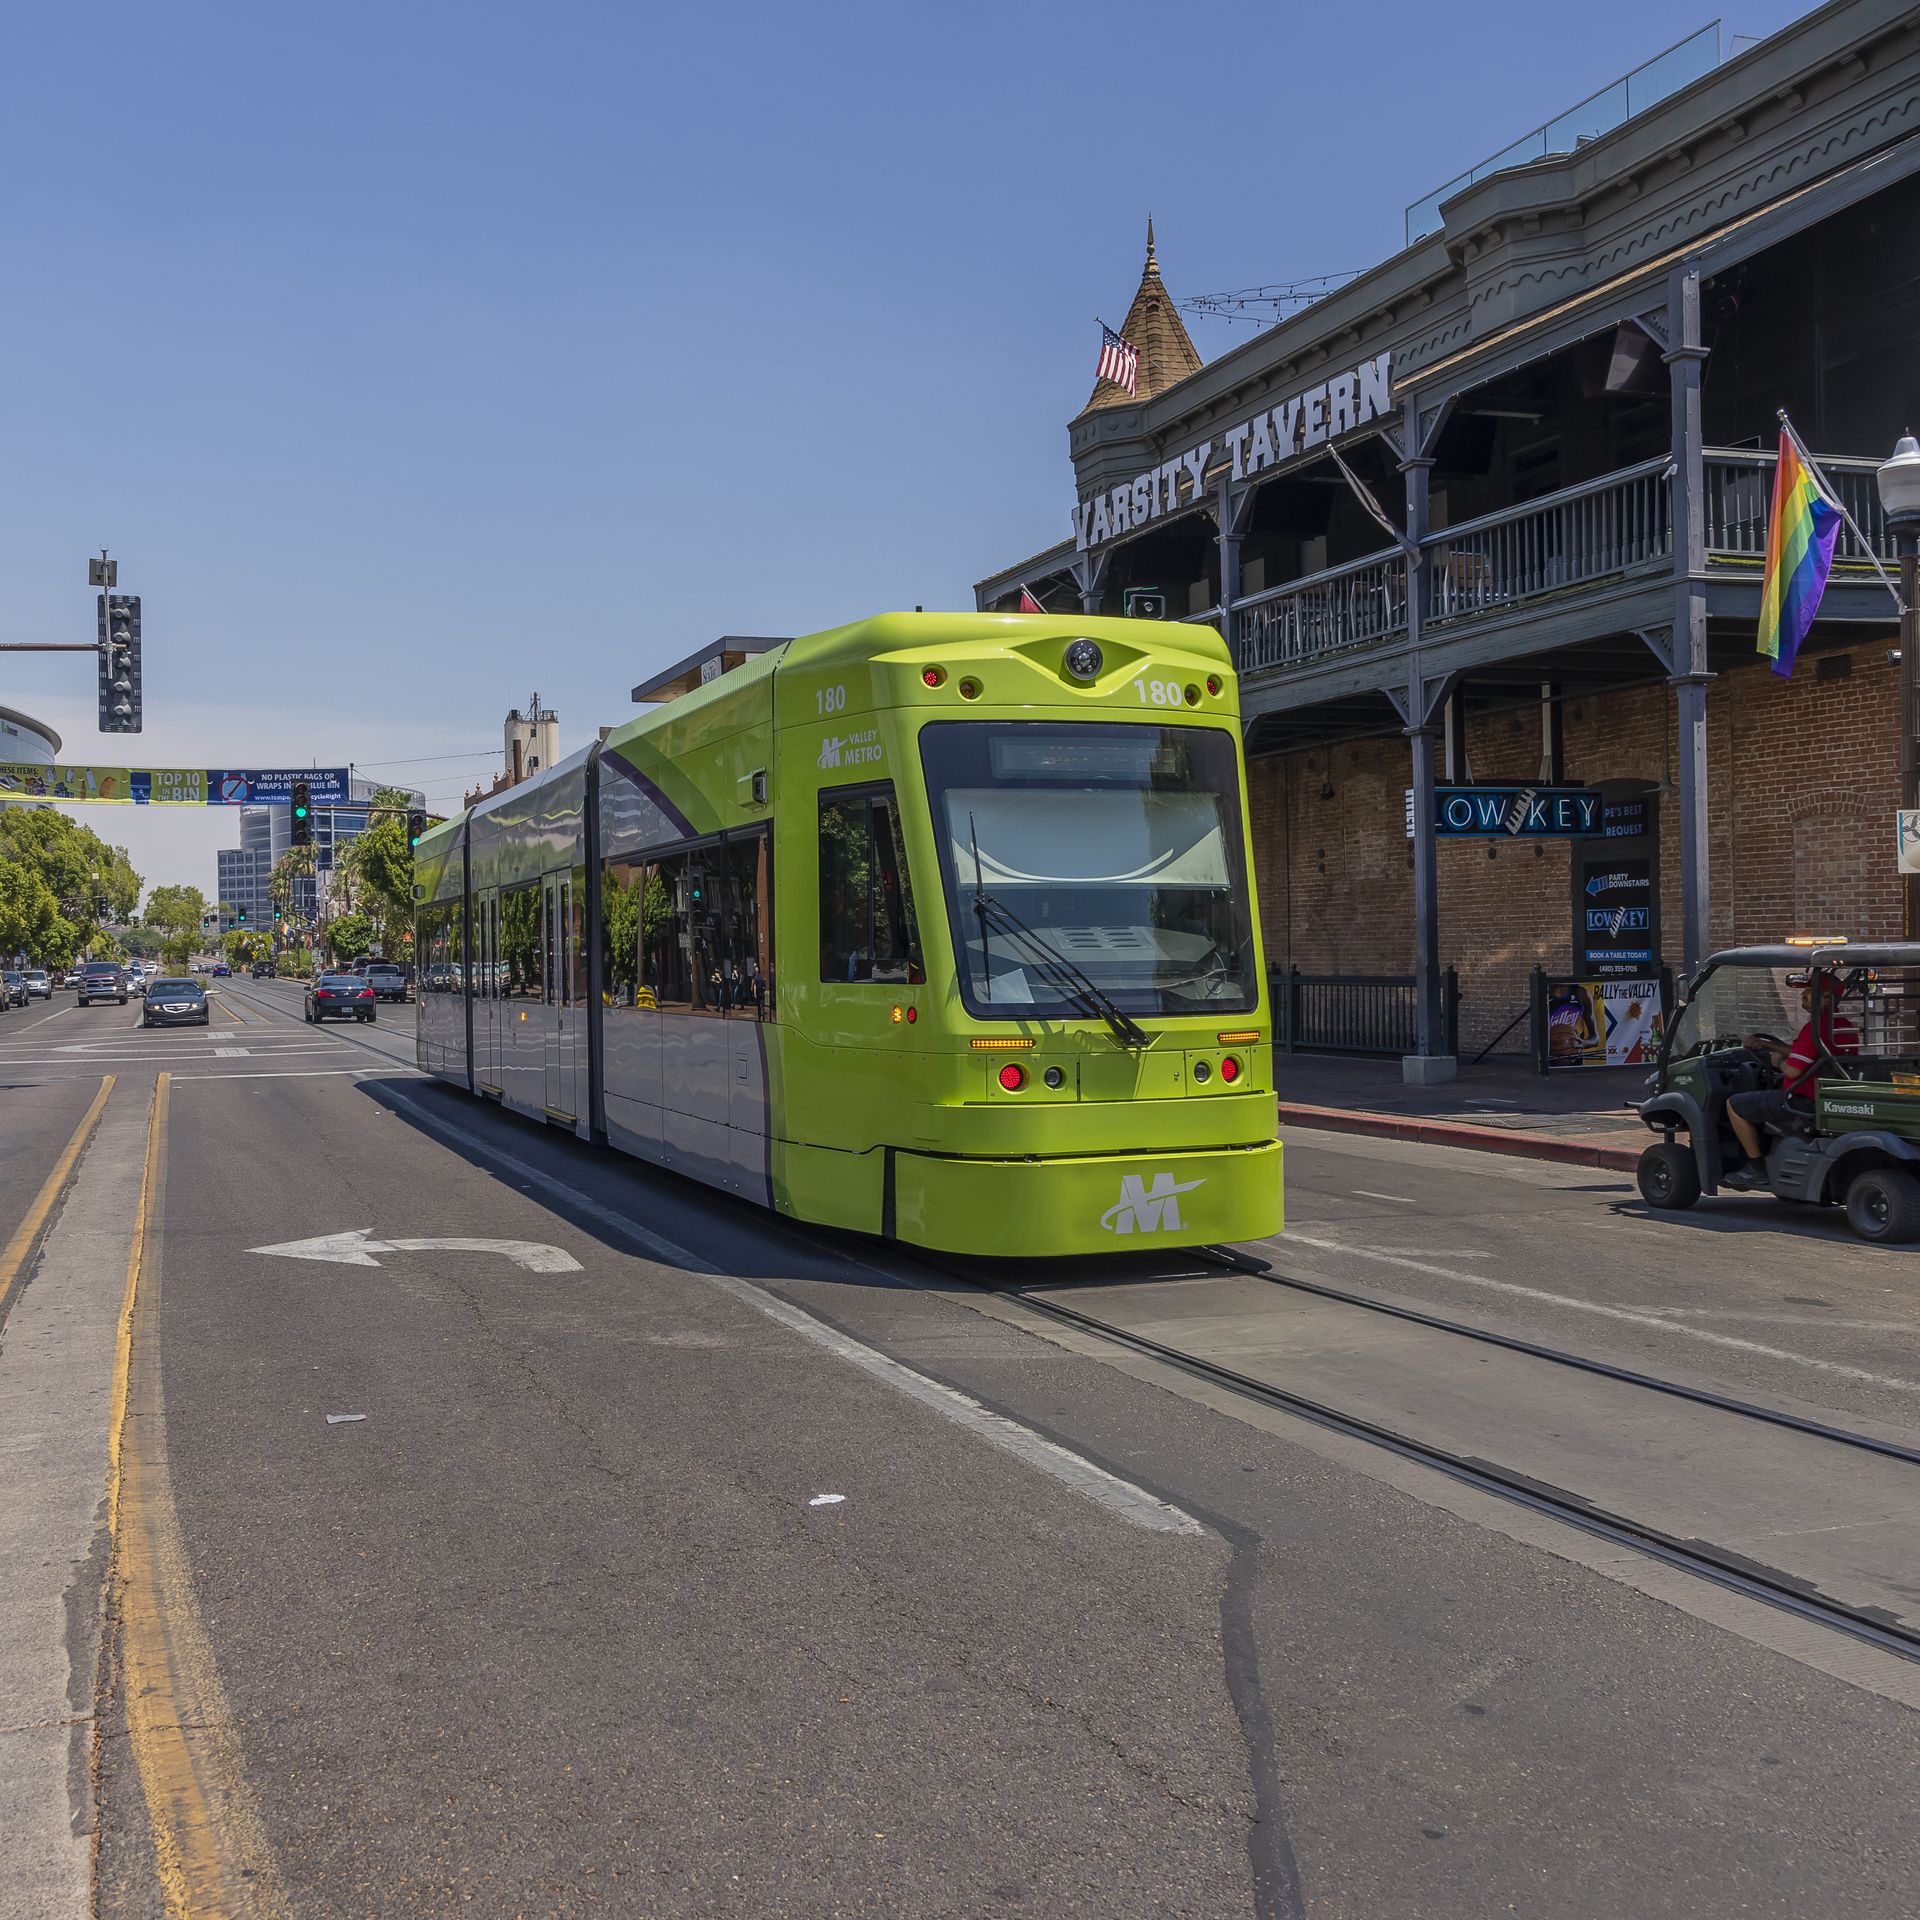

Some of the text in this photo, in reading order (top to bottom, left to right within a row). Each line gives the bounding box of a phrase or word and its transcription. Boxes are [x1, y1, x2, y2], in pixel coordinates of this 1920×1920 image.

[1071, 352, 1394, 551] VARSITY TAVERN
[816, 685, 846, 715] 180
[1133, 679, 1182, 706] 180
[849, 729, 877, 744] VALLEY
[845, 744, 882, 765] METRO
[156, 773, 200, 786] TOP 10
[275, 773, 302, 781] PLASTIC
[172, 788, 200, 802] BIN
[1530, 799, 1595, 827] KEY
[1624, 805, 1642, 816] BEST
[1606, 824, 1642, 837] REQUEST
[1609, 879, 1649, 888] DOWNSTAIRS
[1593, 982, 1657, 999] RALLY THE VALLEY
[1824, 1101, 1874, 1116] Kawasaki
